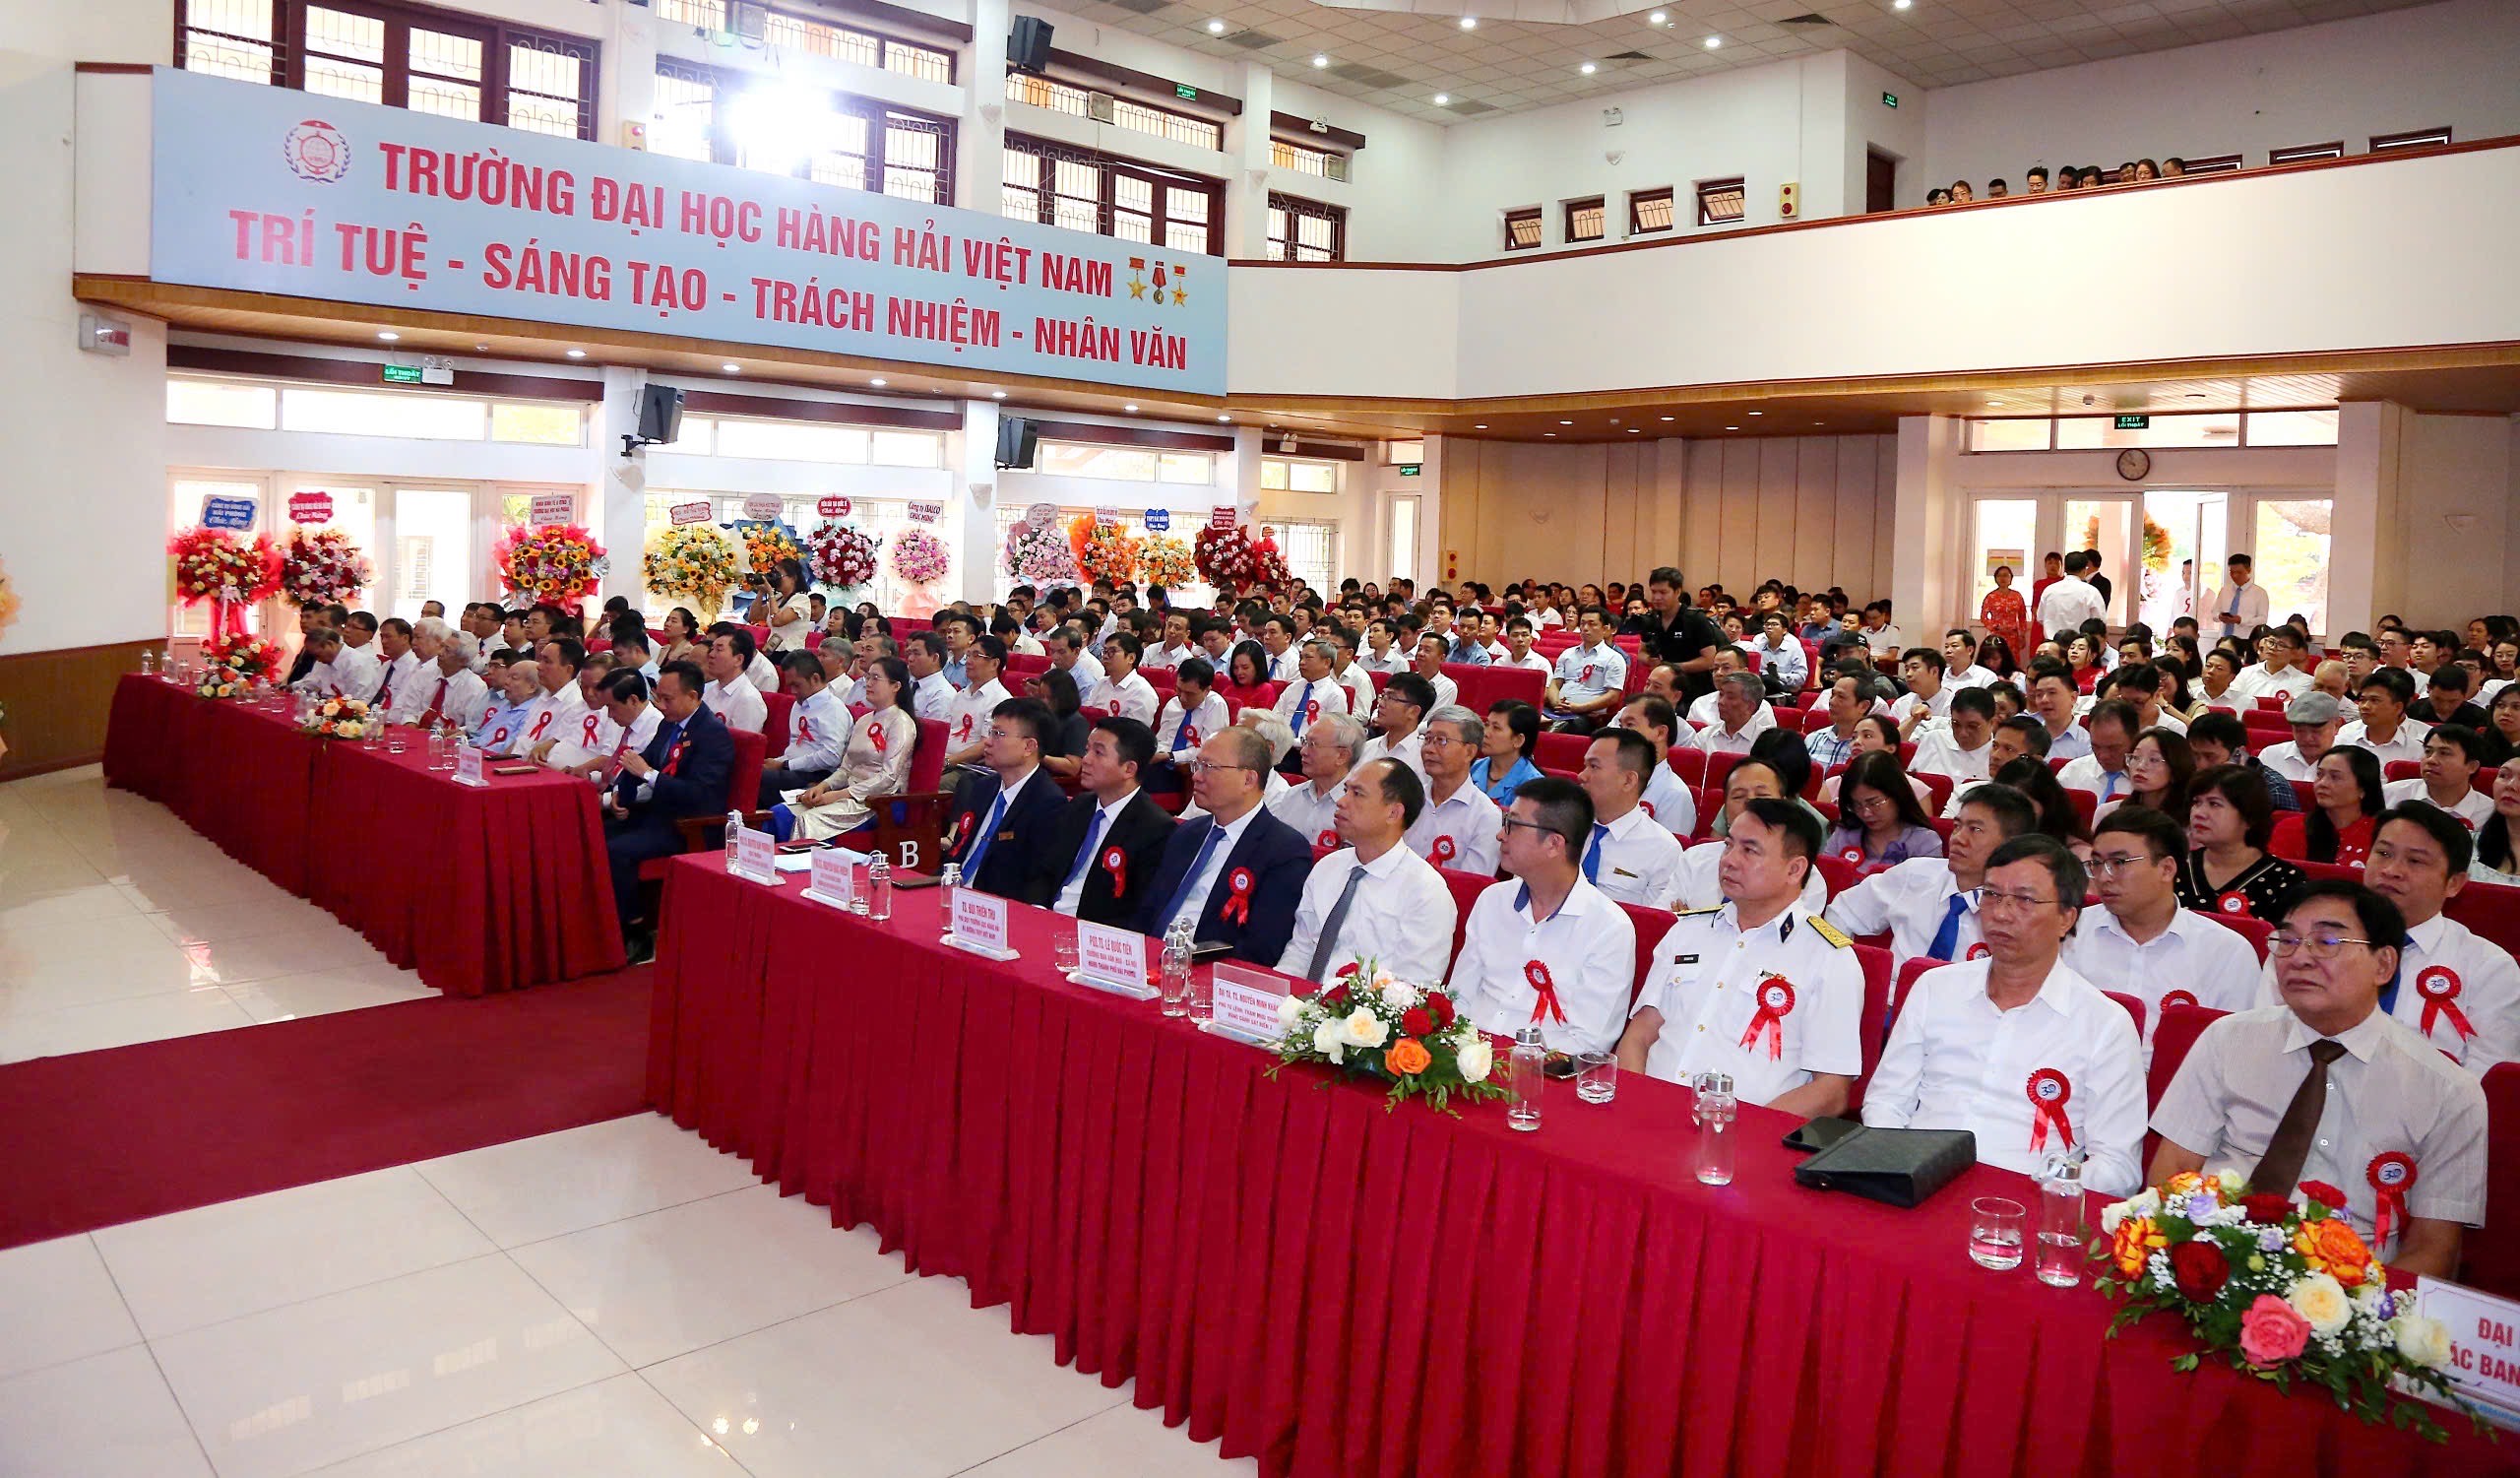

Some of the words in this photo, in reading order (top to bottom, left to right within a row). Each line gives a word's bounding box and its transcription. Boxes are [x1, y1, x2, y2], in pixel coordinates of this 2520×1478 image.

[378, 141, 575, 217] TRƯỜNG
[591, 176, 664, 236] ĐẠI
[680, 191, 762, 249] HỌC
[777, 203, 880, 262] HÀNG
[894, 219, 952, 273] HẢI
[963, 236, 1033, 290] VIỆT
[1041, 251, 1113, 298] NAM
[229, 208, 314, 267] TRÍ
[335, 222, 428, 291] TUỆ
[448, 260, 464, 269] -
[482, 237, 612, 301] SÁNG
[627, 260, 708, 318] TẠO
[751, 277, 875, 333] TRÁCH
[887, 296, 1001, 353] NHIỆM
[1035, 315, 1120, 363] NHÂN
[1129, 326, 1187, 371] VĂN
[899, 840, 919, 868] B
[1239, 994, 1255, 1006] NGUYỄN
[1256, 998, 1267, 1009] MINH
[2478, 1317, 2513, 1349] ĐẠI
[2450, 1340, 2474, 1371] ÁC
